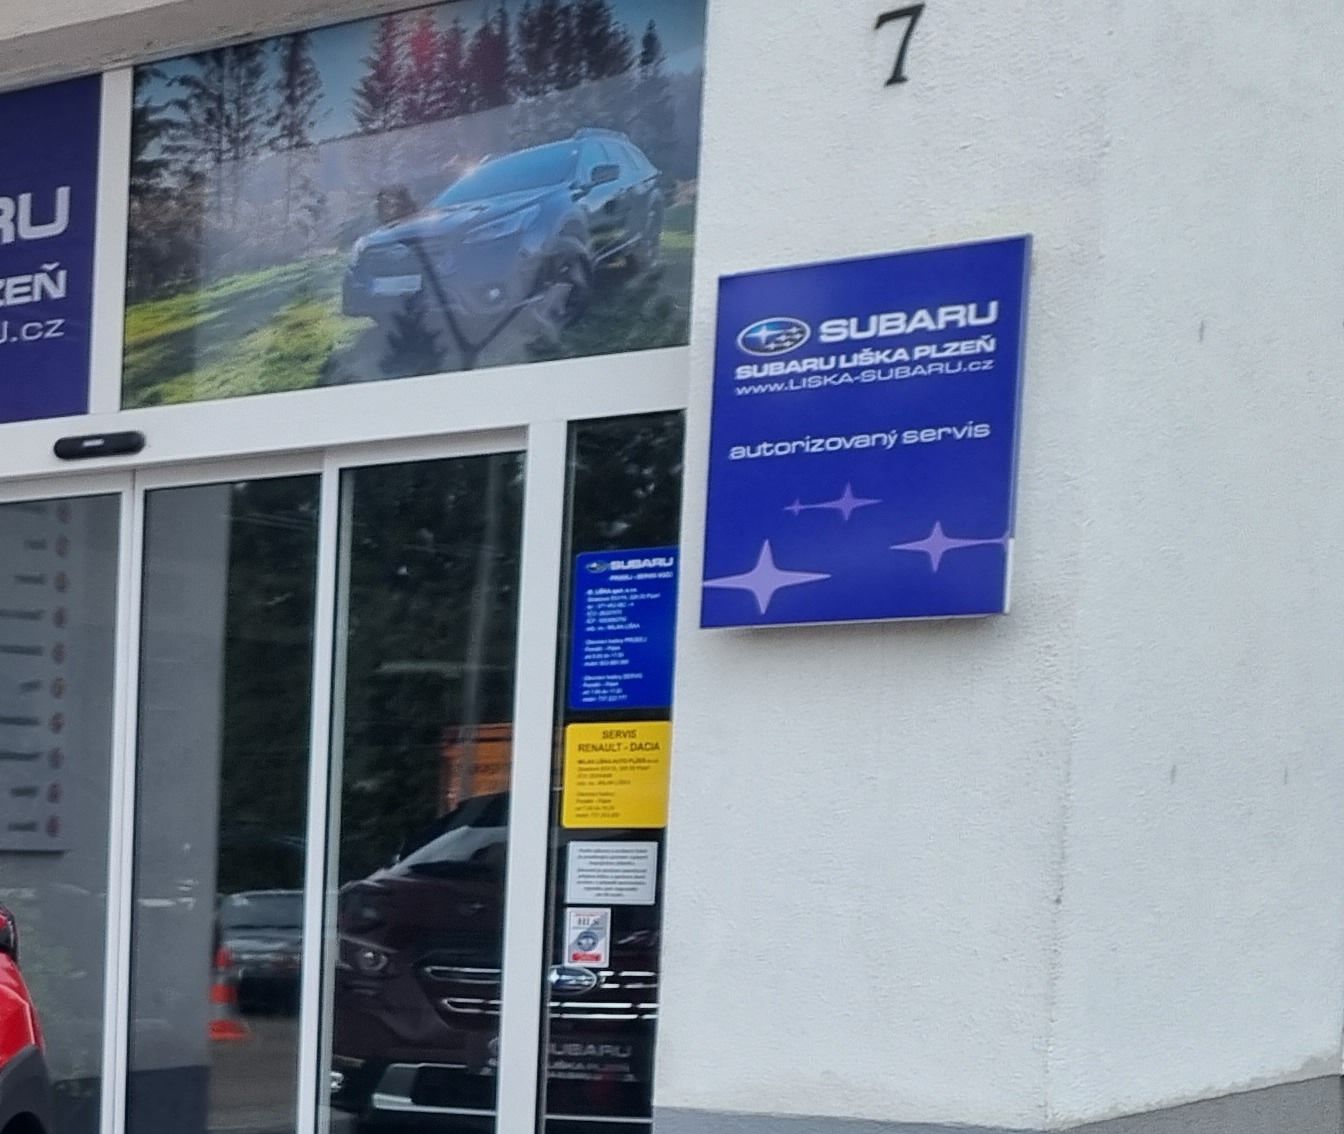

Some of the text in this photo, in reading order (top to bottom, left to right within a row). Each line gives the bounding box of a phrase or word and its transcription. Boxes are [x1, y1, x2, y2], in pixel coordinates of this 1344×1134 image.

[874, 3, 925, 87] 7
[819, 300, 999, 344] SUBARU
[734, 334, 997, 381] SUBARU LIŠKA PLZEŇ
[734, 358, 994, 396] www.LISKA-SUBARU.cz
[728, 421, 992, 461] autorizovaný servis
[610, 557, 674, 571] SUBARU
[577, 742, 622, 753] RENAULT
[629, 742, 661, 752] DACIA
[602, 729, 637, 740] SERVIS
